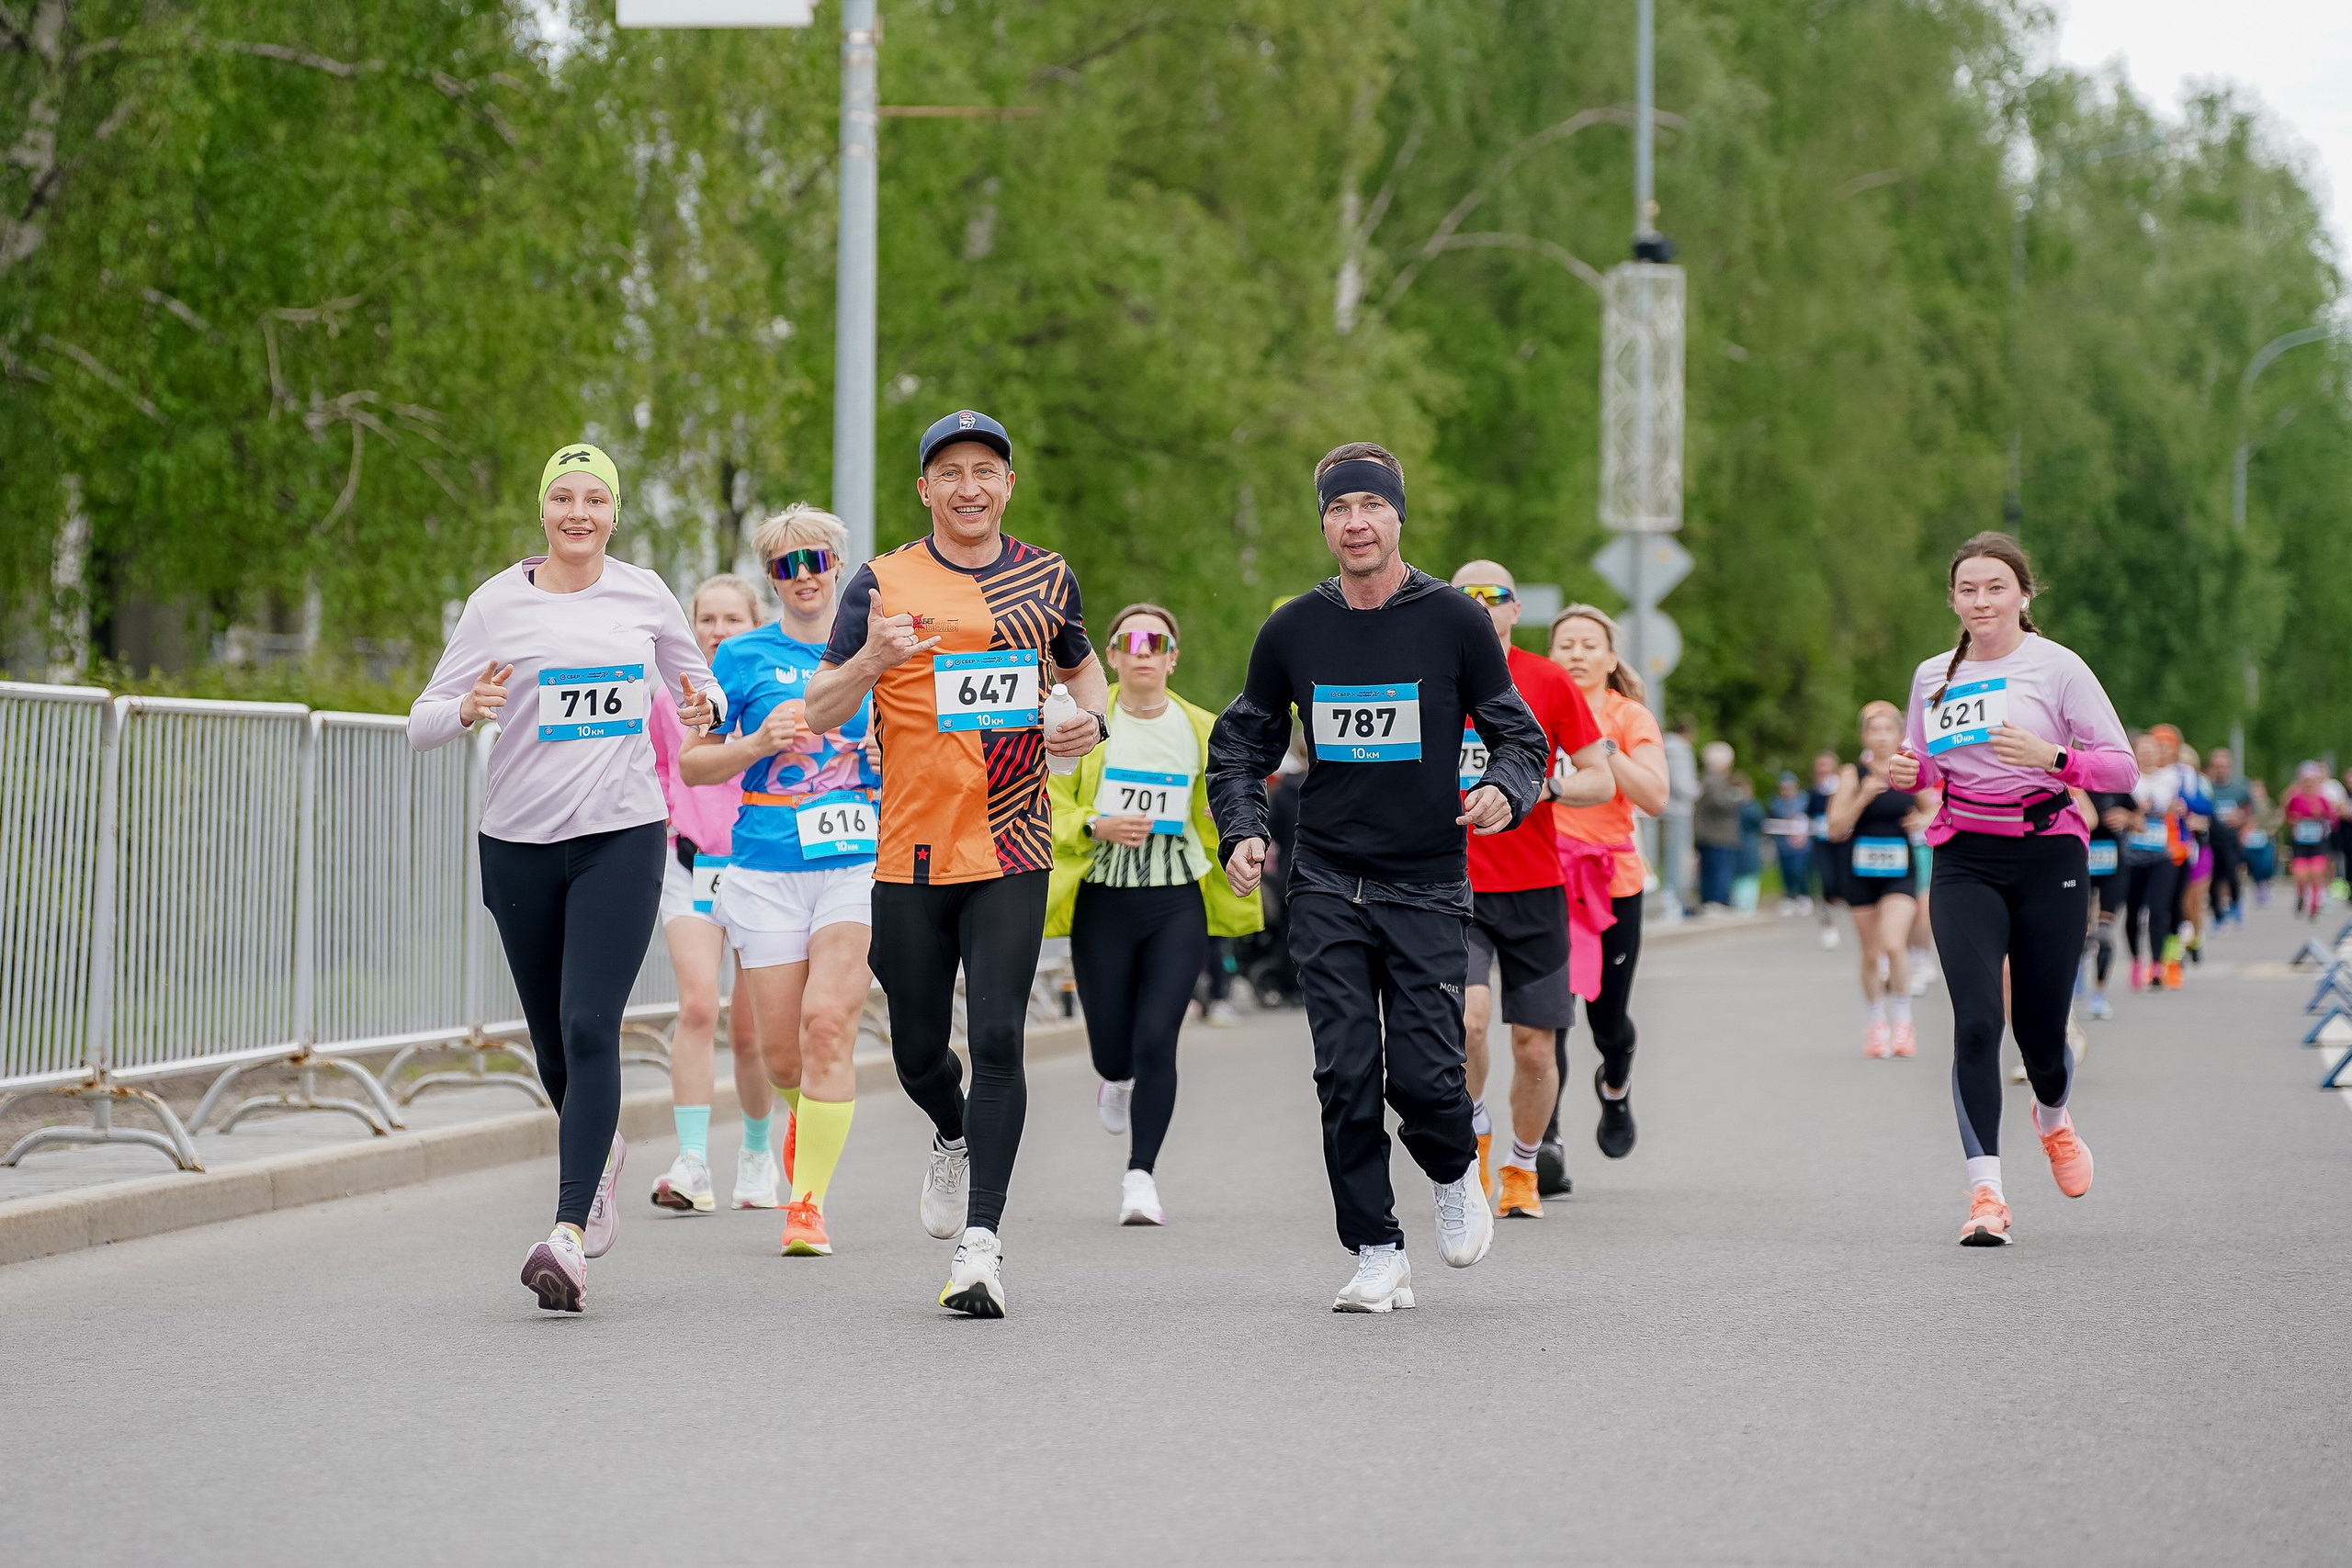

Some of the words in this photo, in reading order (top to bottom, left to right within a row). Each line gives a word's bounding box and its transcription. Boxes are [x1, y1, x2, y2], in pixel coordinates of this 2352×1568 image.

[560, 687, 622, 718] 716
[958, 673, 1019, 705] 647
[1332, 707, 1396, 739] 787
[1939, 698, 1985, 730] 621
[1459, 748, 1487, 770] 75
[1121, 787, 1167, 813] 701
[818, 809, 865, 834] 616
